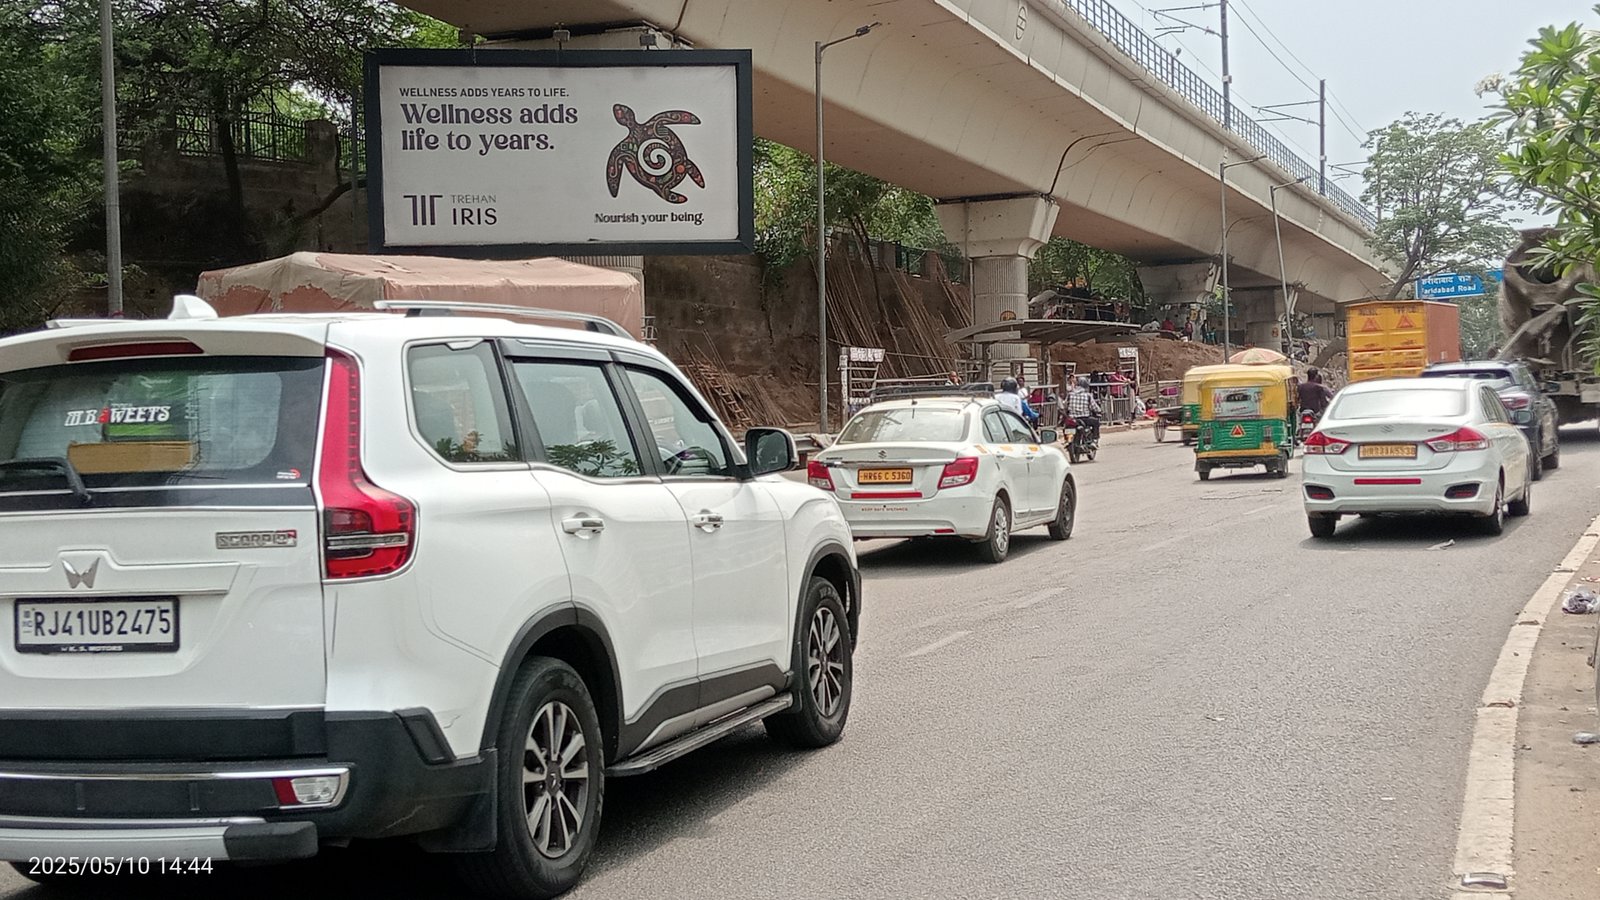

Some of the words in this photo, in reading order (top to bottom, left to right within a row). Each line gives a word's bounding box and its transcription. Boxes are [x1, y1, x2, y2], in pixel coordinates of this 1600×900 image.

[399, 87, 457, 98] WELLNESS
[460, 87, 489, 98] ADDS
[491, 87, 525, 98] YEARS
[527, 87, 541, 98] TO
[544, 87, 570, 98] LIFE.
[400, 103, 512, 124] Wellness
[519, 103, 578, 124] adds
[401, 127, 440, 151] life
[446, 130, 472, 151] to
[478, 132, 555, 156] years.
[450, 194, 497, 204] TREHAN
[452, 207, 498, 226] IRIS
[594, 212, 639, 224] Nourish
[641, 213, 669, 225] your
[671, 211, 705, 225] being.
[1457, 283, 1477, 293] Road
[863, 471, 883, 481] HR66
[33, 608, 171, 637] RJ41UB2475
